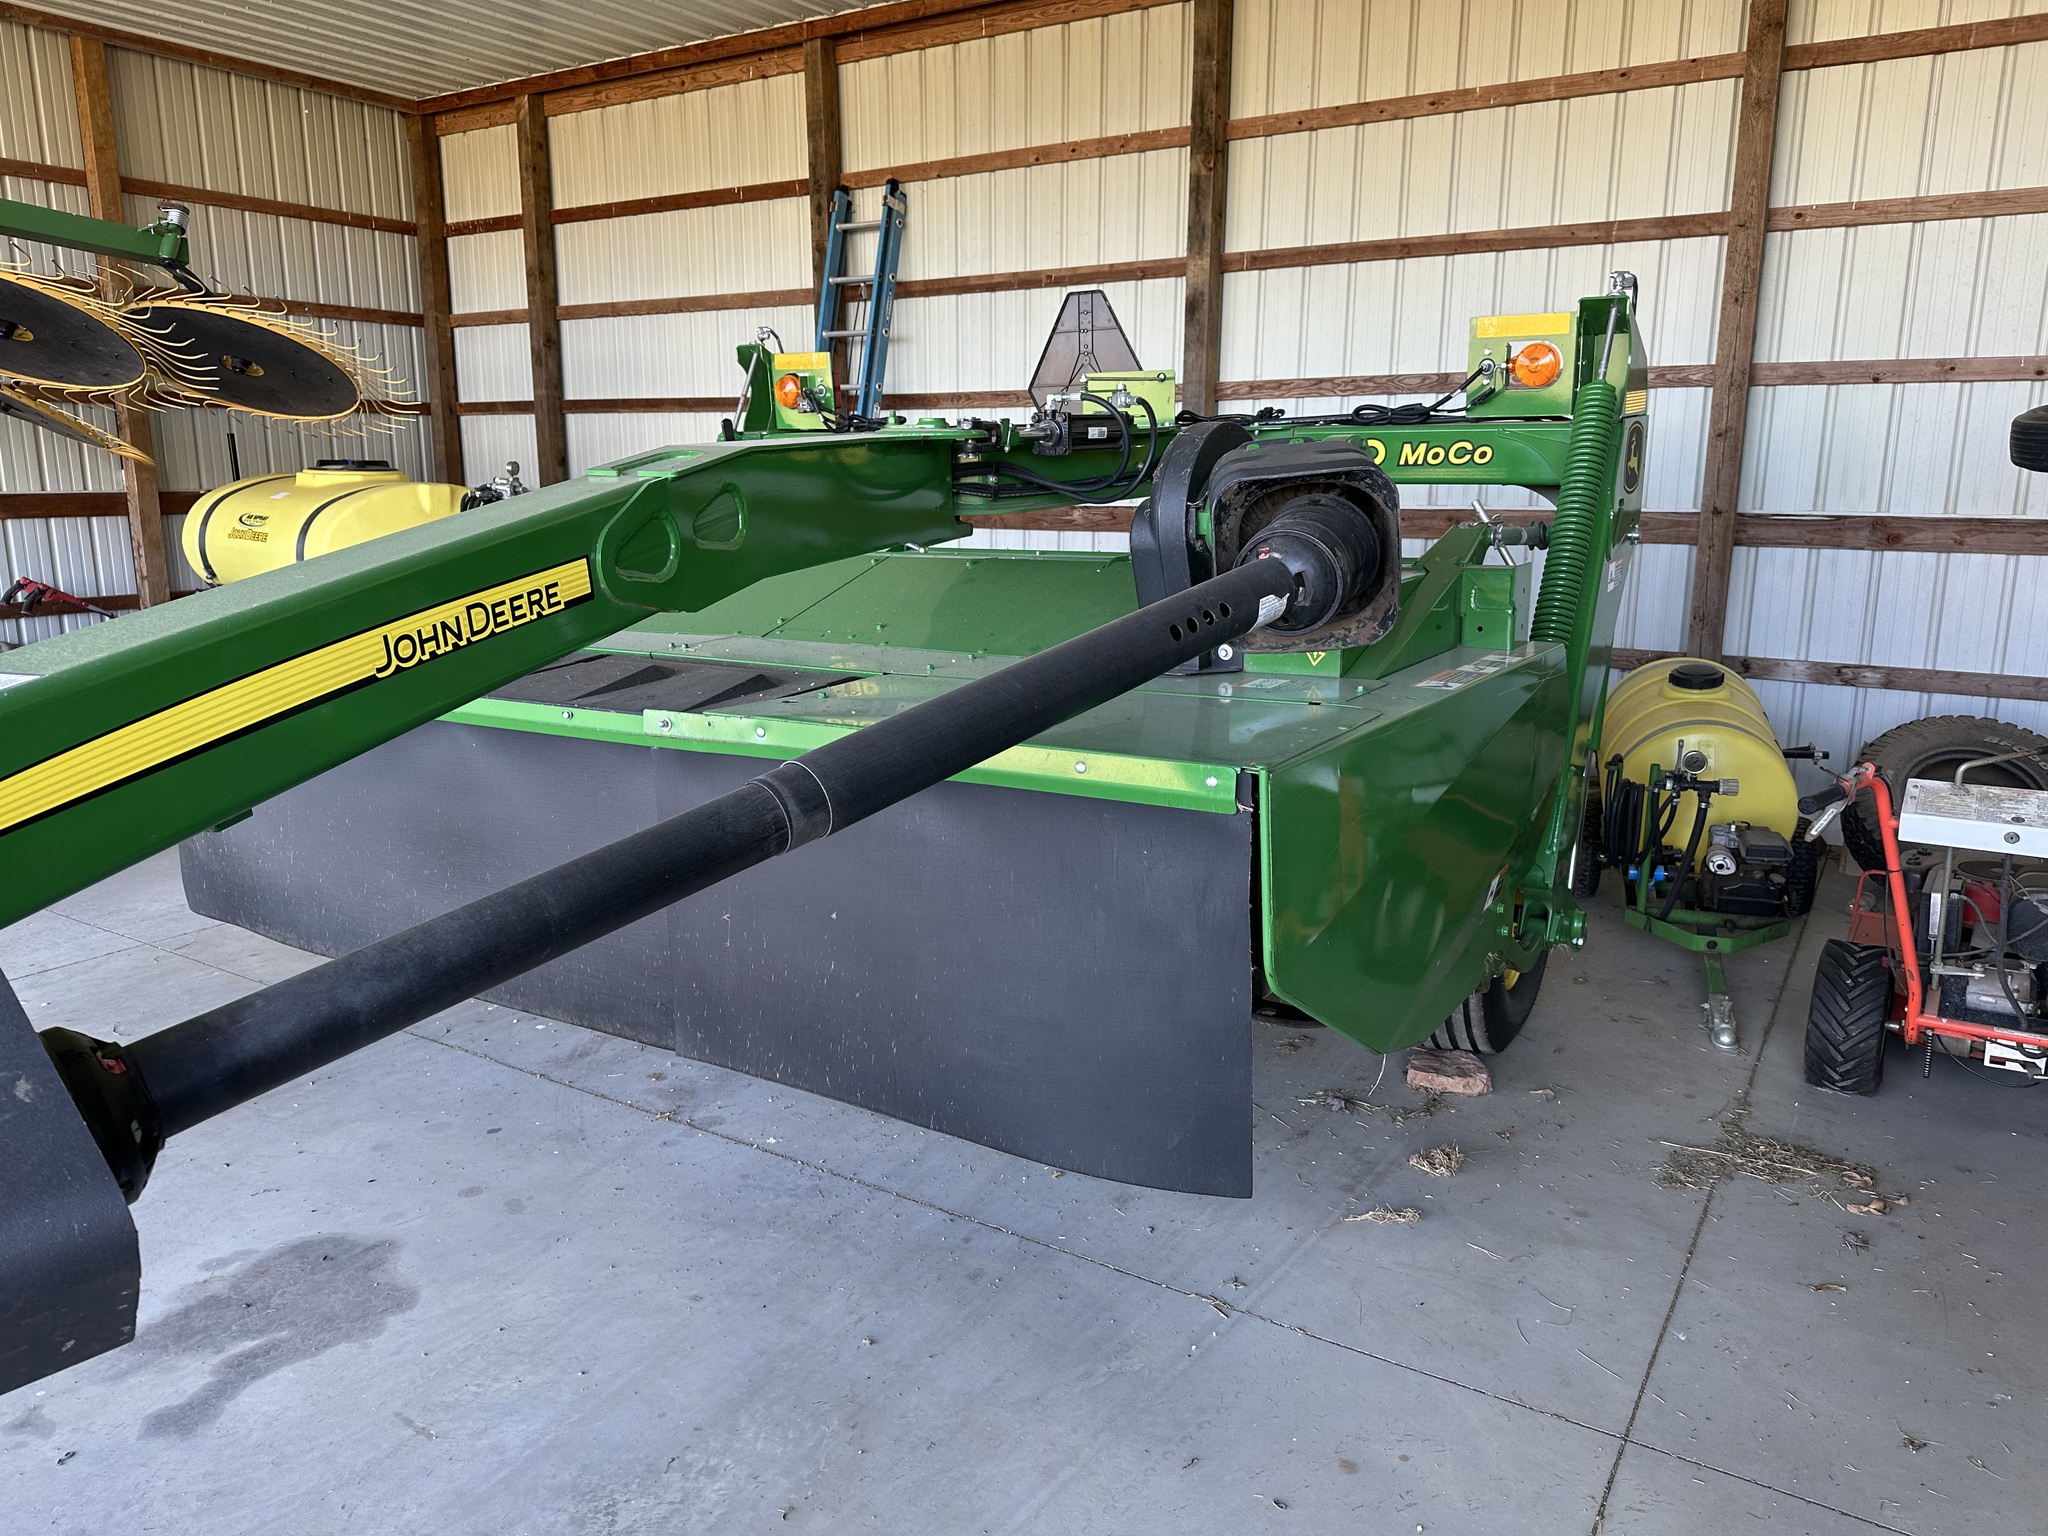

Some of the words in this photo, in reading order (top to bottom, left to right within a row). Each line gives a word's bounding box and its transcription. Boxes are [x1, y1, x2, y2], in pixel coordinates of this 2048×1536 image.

[1397, 440, 1494, 467] MoCo
[228, 527, 247, 540] JOHN
[245, 529, 268, 542] DEERE
[375, 614, 465, 676] JOHN
[465, 580, 562, 639] DEERE
